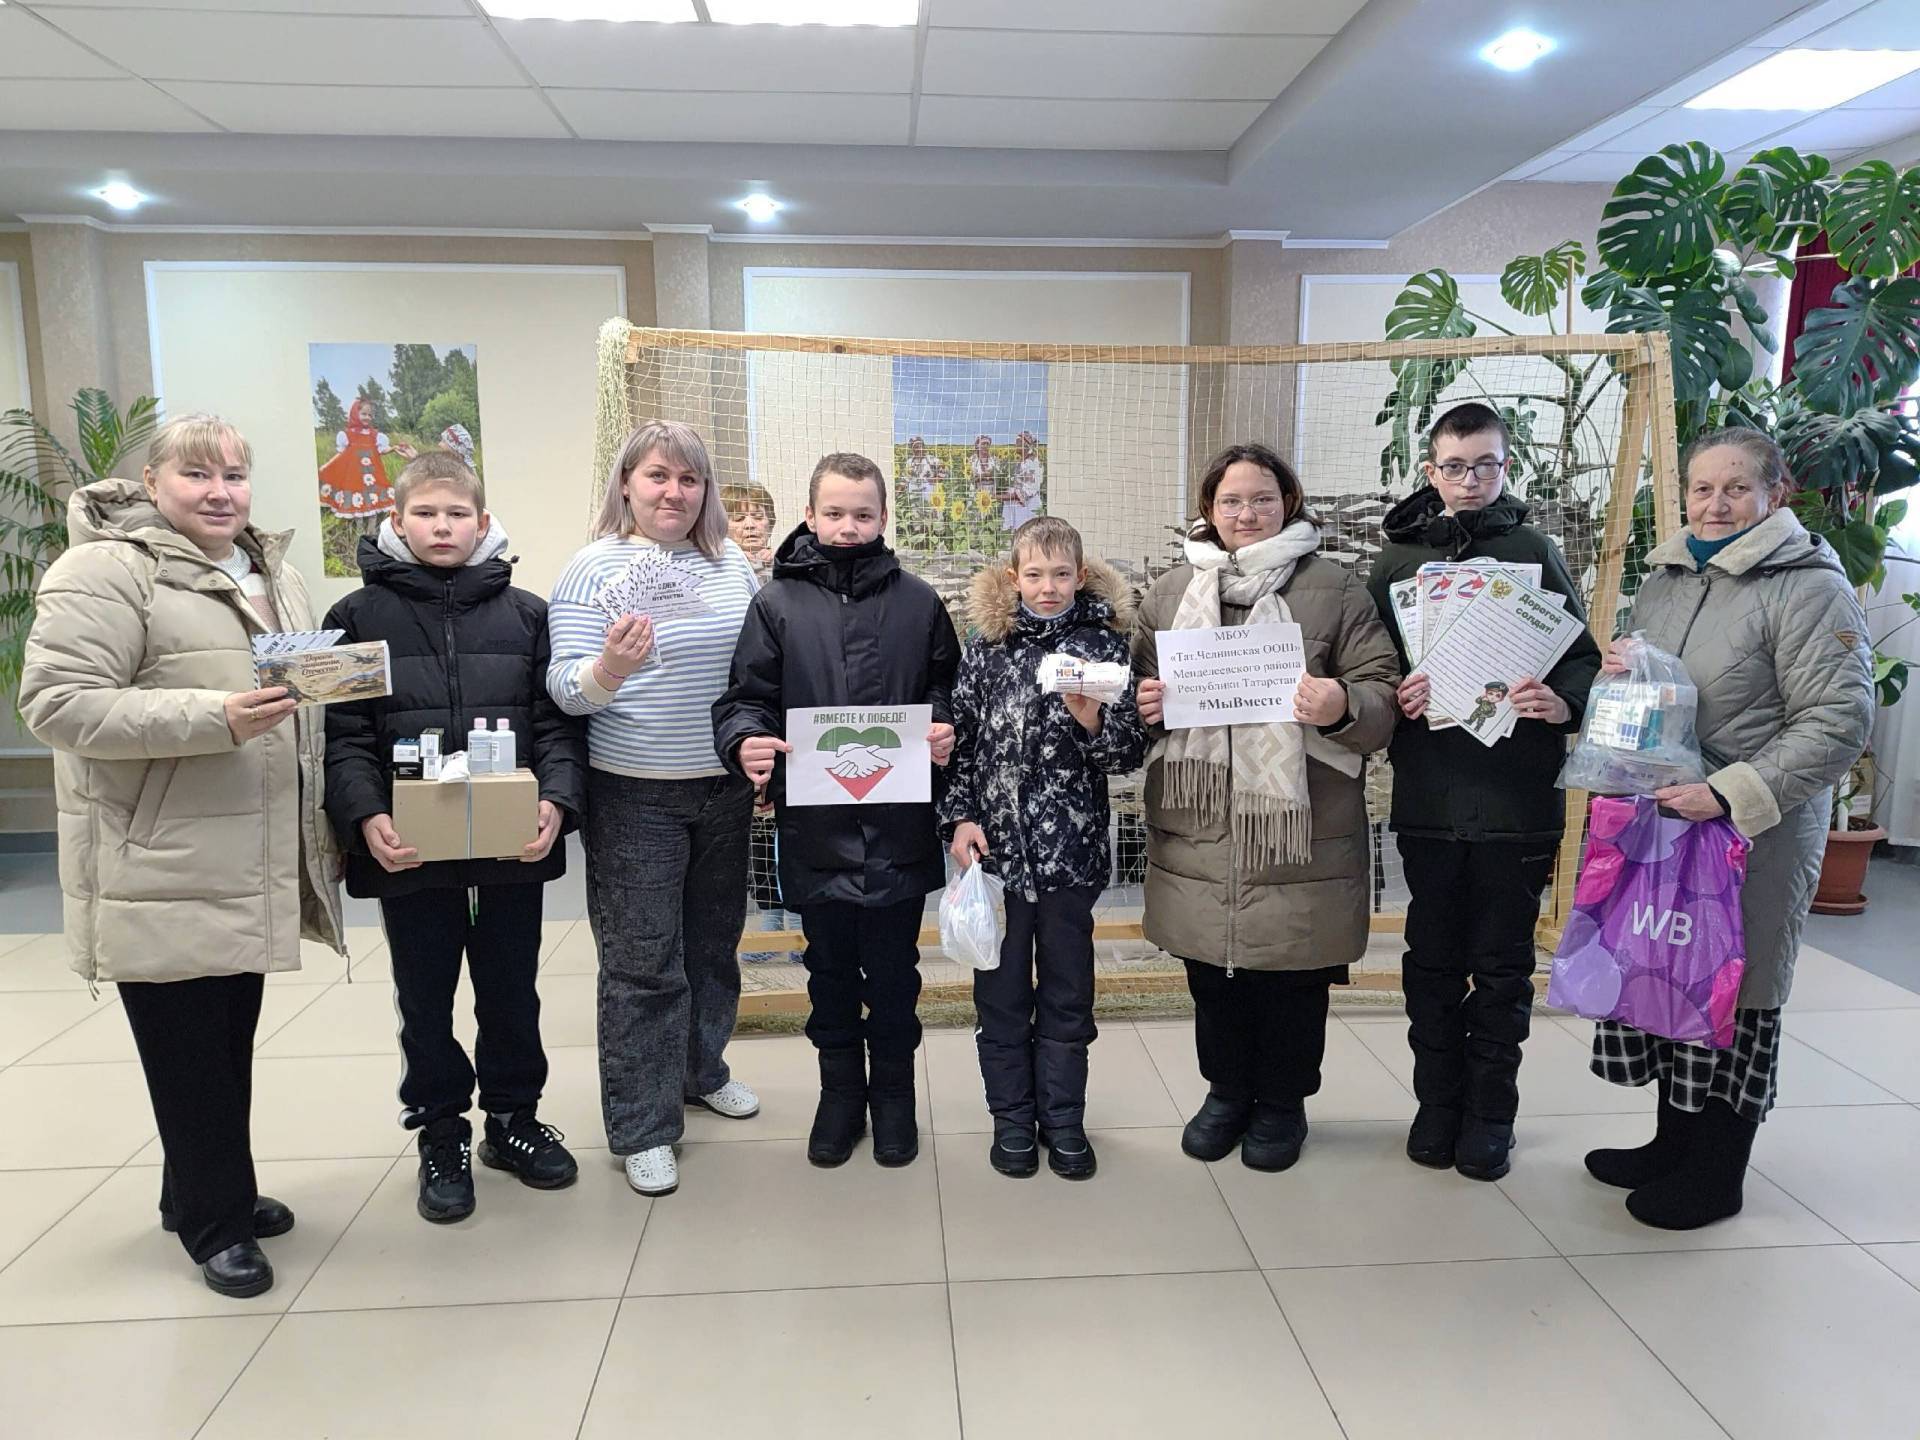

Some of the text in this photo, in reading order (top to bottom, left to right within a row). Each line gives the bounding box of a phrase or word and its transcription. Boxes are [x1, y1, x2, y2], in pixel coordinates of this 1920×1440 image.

[1518, 593, 1562, 625] Дорогой
[1515, 607, 1554, 635] солдат!
[1214, 630, 1250, 641] МБОУ
[1263, 643, 1300, 654] ООШ»
[1173, 660, 1301, 680] Менделеевского района
[1177, 676, 1296, 694] Республики Татарстан
[1199, 696, 1282, 711] #МыВместе
[813, 711, 907, 725] #ВМЕСТЕ К ПОБЕДЕ!
[1632, 901, 1693, 946] WB
